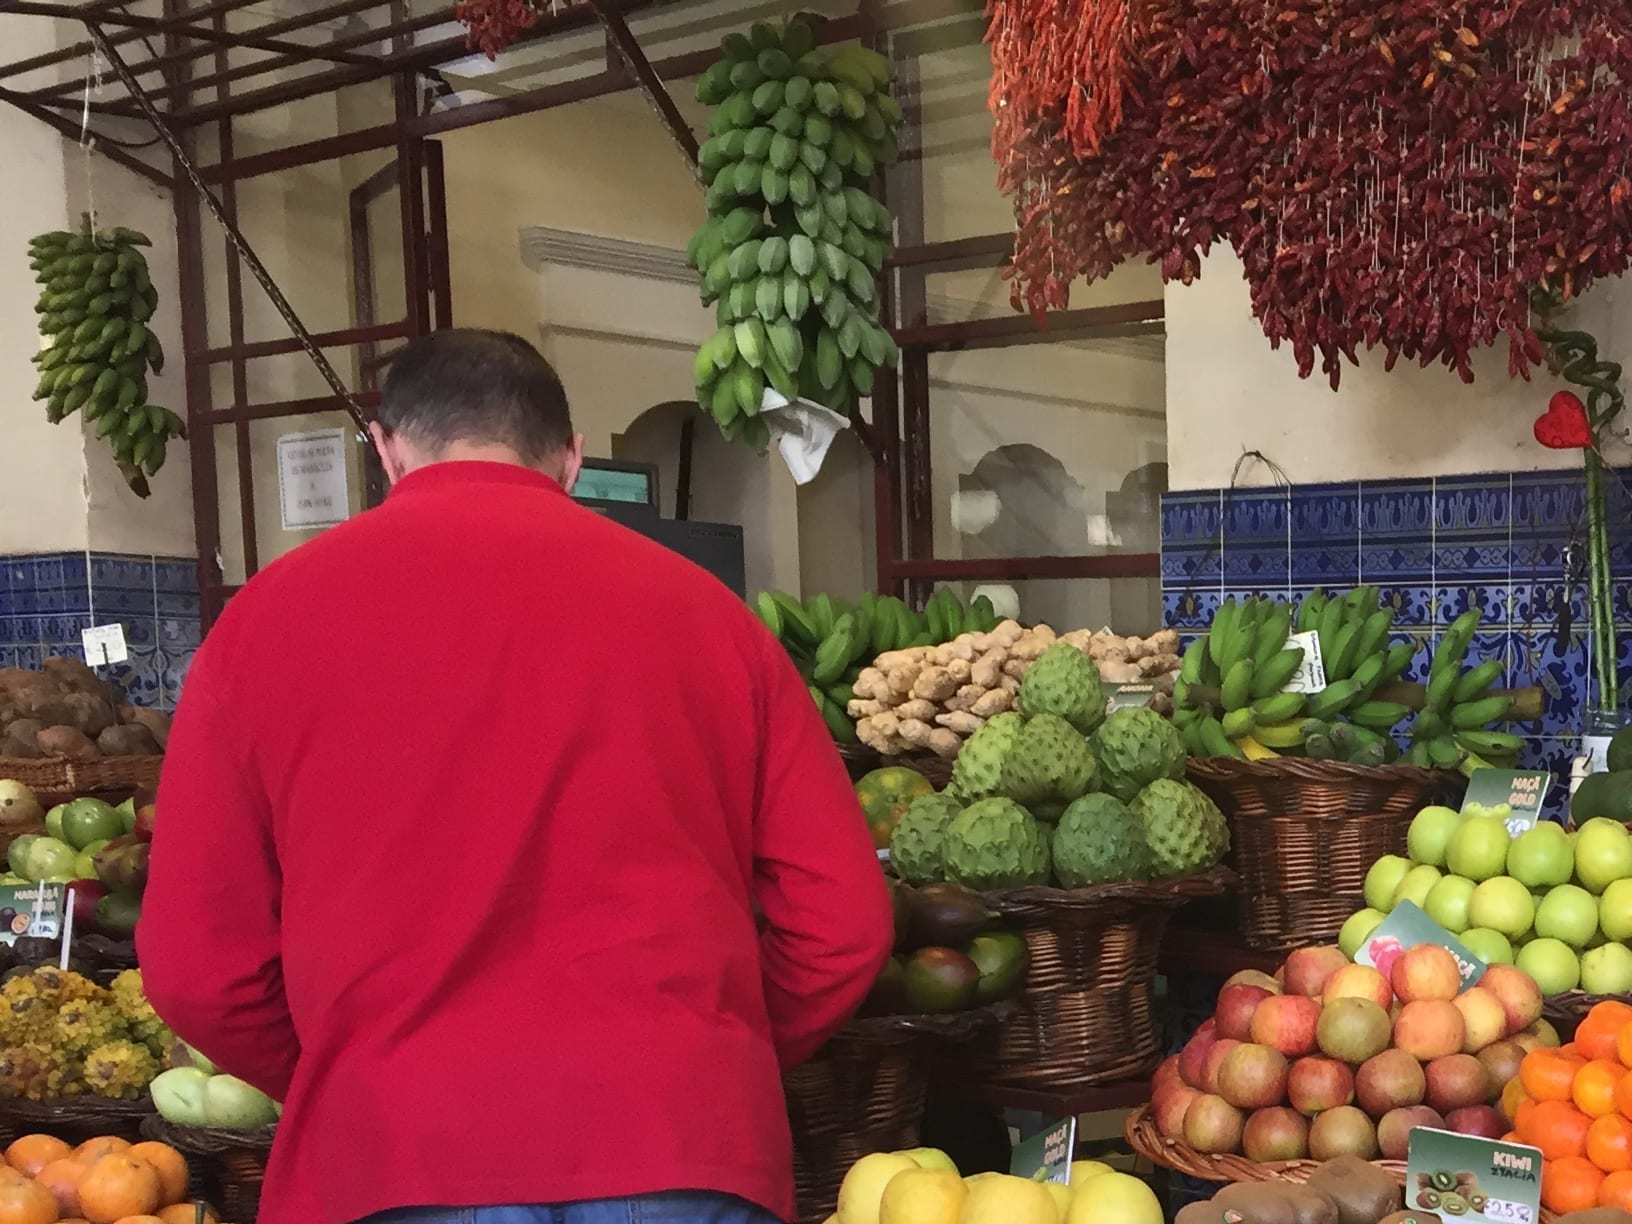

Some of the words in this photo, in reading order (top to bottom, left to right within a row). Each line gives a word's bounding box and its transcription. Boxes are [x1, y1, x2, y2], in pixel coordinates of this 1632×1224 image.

[1511, 776, 1541, 792] MAÇÃ
[1508, 792, 1536, 806] GOLD
[1492, 1151, 1532, 1170] KIWI
